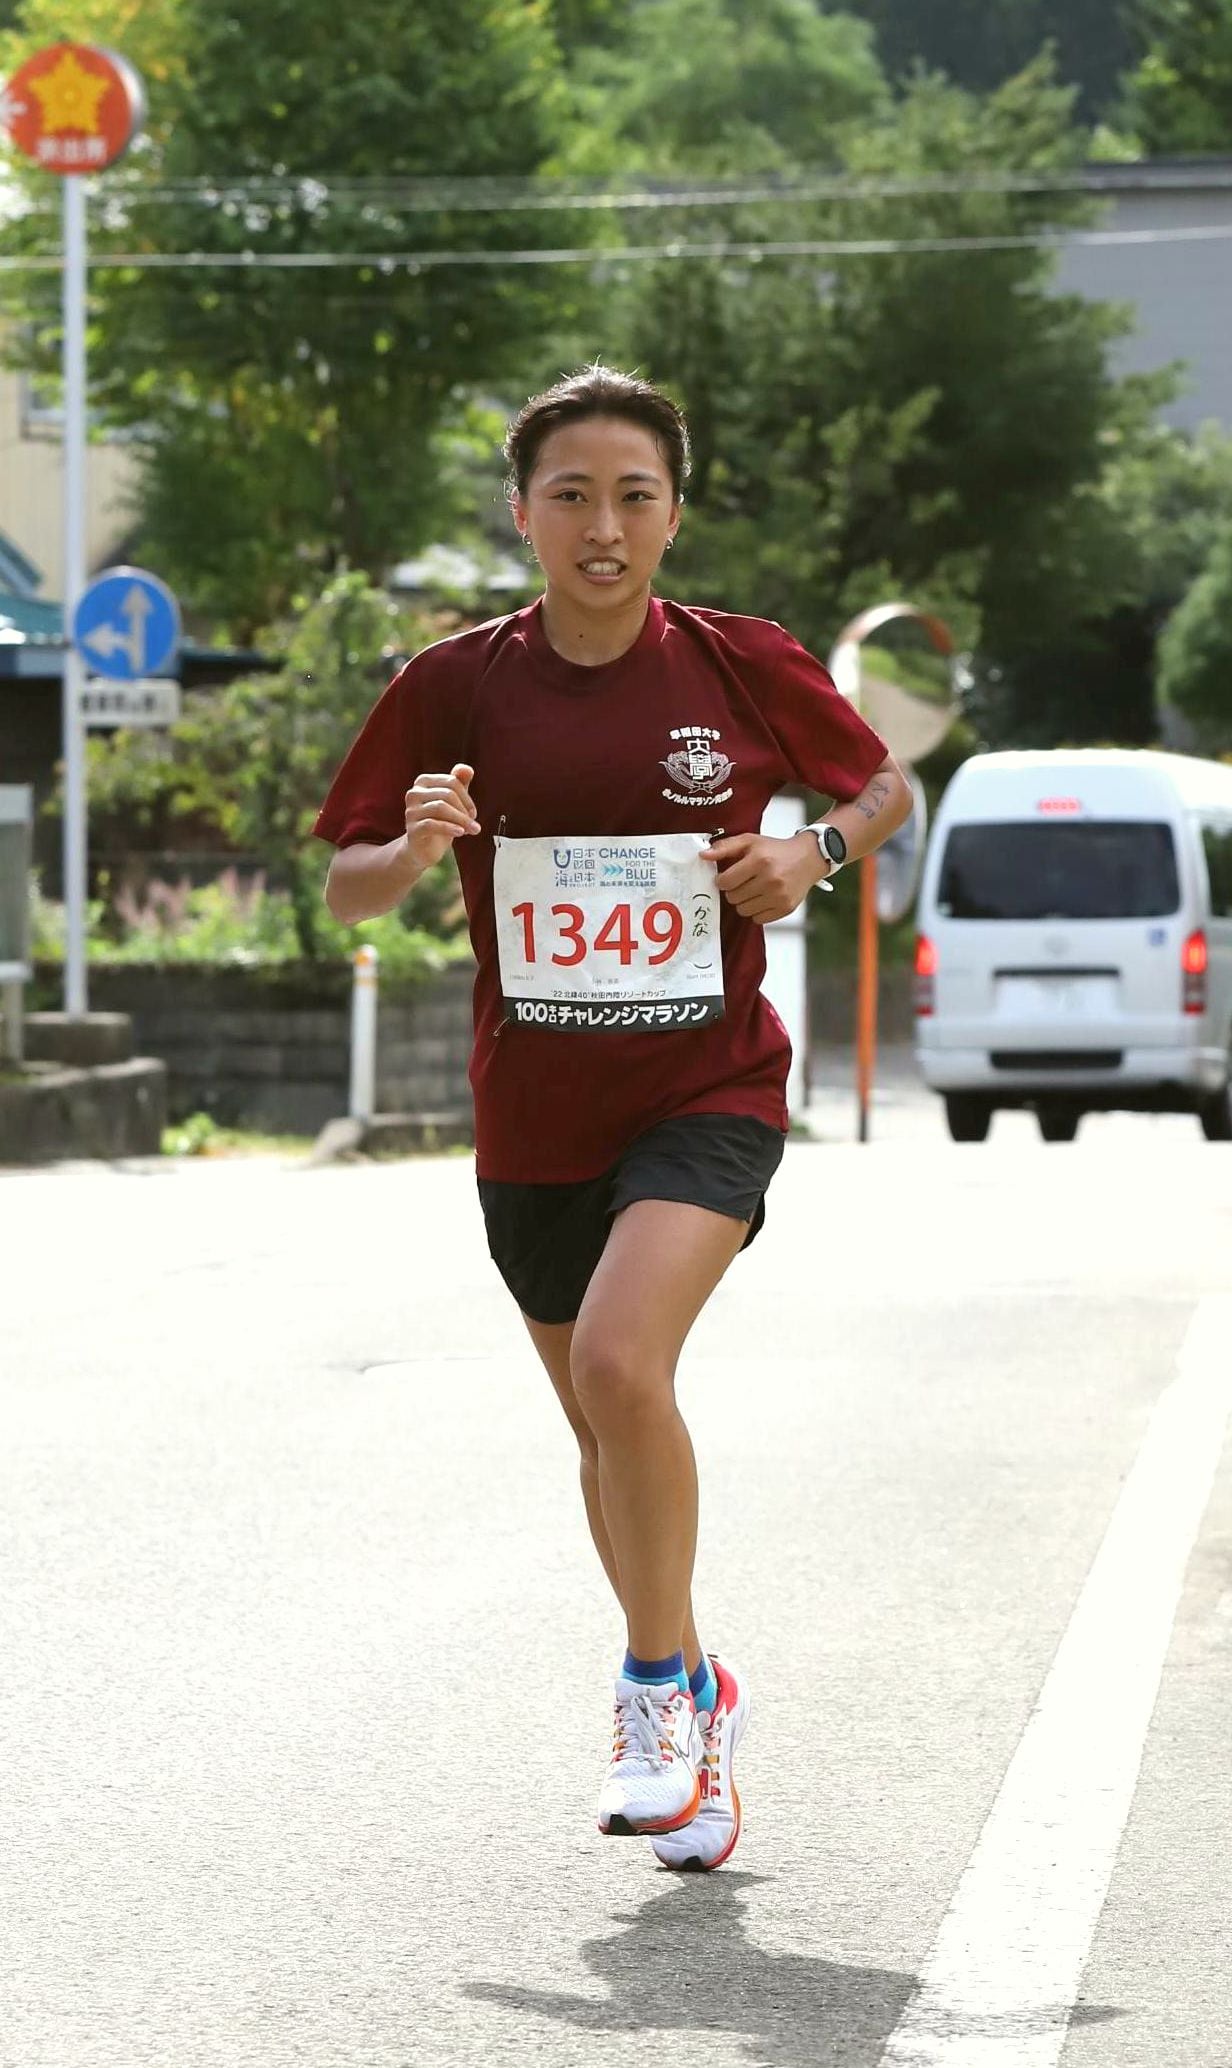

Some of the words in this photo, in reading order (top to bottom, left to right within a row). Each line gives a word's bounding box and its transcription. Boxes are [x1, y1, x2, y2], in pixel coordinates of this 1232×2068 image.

[599, 847, 656, 859] CHANGE
[625, 868, 656, 879] BLUE
[511, 901, 683, 966] 1349
